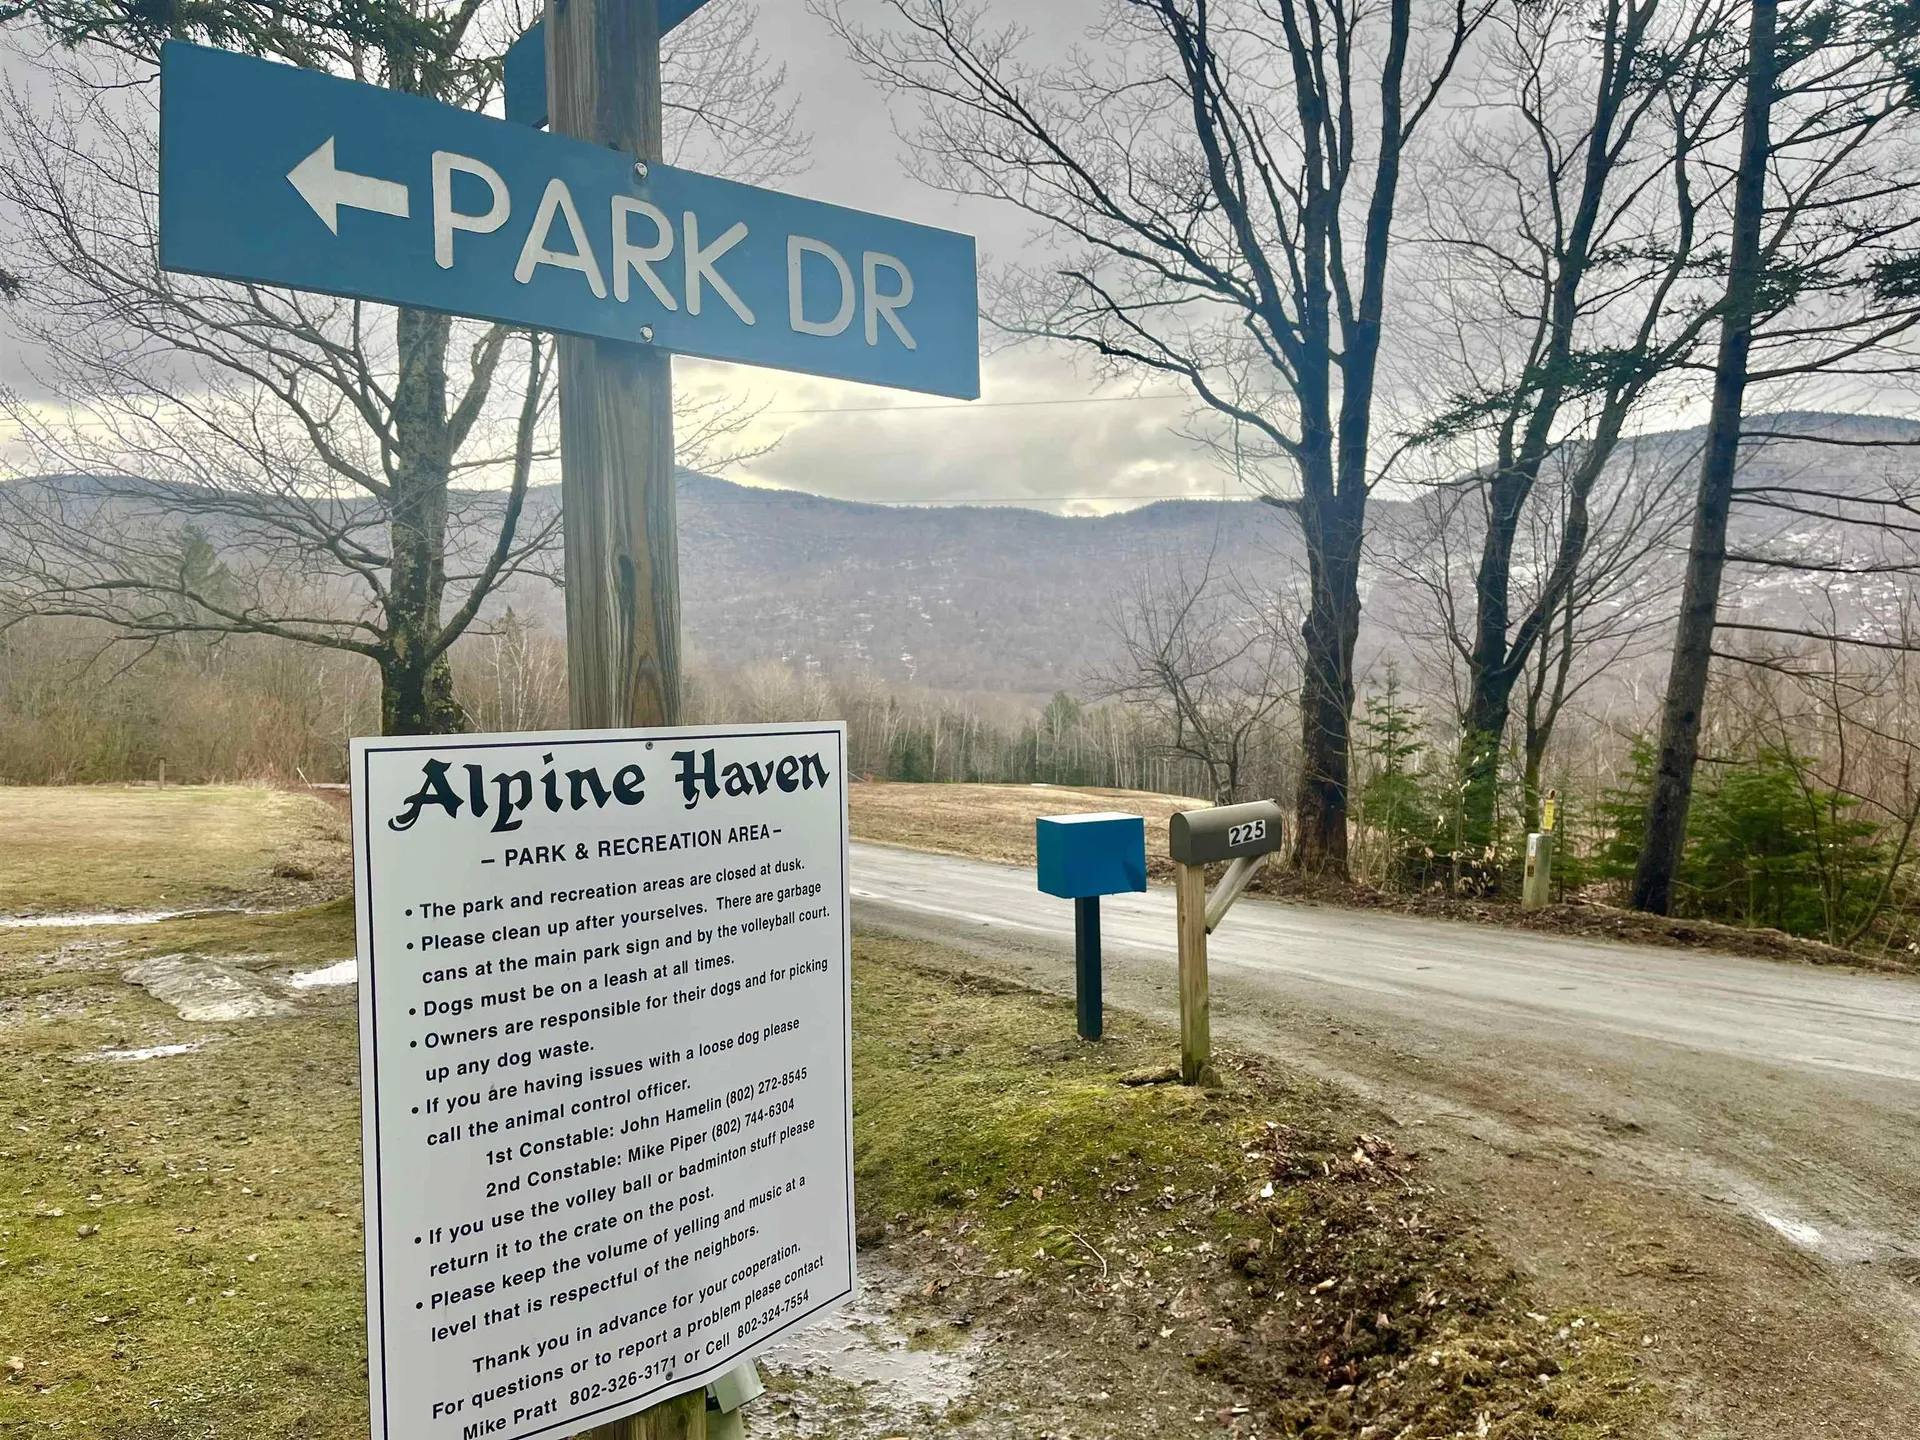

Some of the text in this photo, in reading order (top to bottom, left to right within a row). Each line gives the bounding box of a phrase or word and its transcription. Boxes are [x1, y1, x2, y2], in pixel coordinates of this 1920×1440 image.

[431, 151, 917, 351] PARK DR
[387, 748, 831, 834] Alpine Haven
[1230, 820, 1264, 845] 225
[419, 857, 805, 919] The park and recreation areas are closed at dusk.
[504, 843, 567, 868] PARK
[574, 842, 590, 861] &
[598, 828, 722, 858] RECREATION
[421, 882, 822, 952] Please clean up after yourselves. There are garbage
[422, 905, 830, 984] cans at the main park sign and by the volleyball court.
[423, 954, 734, 1017] Dogs must be on a leash at all times.
[424, 958, 828, 1049] Owners are responsible for their dogs and for picking
[425, 1040, 594, 1084] up any dog waste.
[426, 1018, 800, 1114] If you are having issues with a loose dog please
[426, 1078, 691, 1146] call the animal control officer.
[486, 1066, 808, 1166] 1st Constable: John Hamelin (802) 272-8545
[486, 1097, 795, 1198] 2nd Constable: Mike Piper (802) 744-6304
[429, 1119, 815, 1245] If you use the volley ball or badminton stuff please
[430, 1186, 714, 1278] return it to the crate on the post.
[431, 1176, 806, 1310] Please keep the volume of yelling and music at a
[431, 1225, 759, 1342] level that is respectful of the neighbors.
[472, 1243, 801, 1374] Thank you in advance for your cooperation.
[432, 1254, 824, 1420] For questions or to report a problem please contact
[463, 1288, 809, 1440] Mike Pratt 802-326-3171 or Cell 802-324-7554
